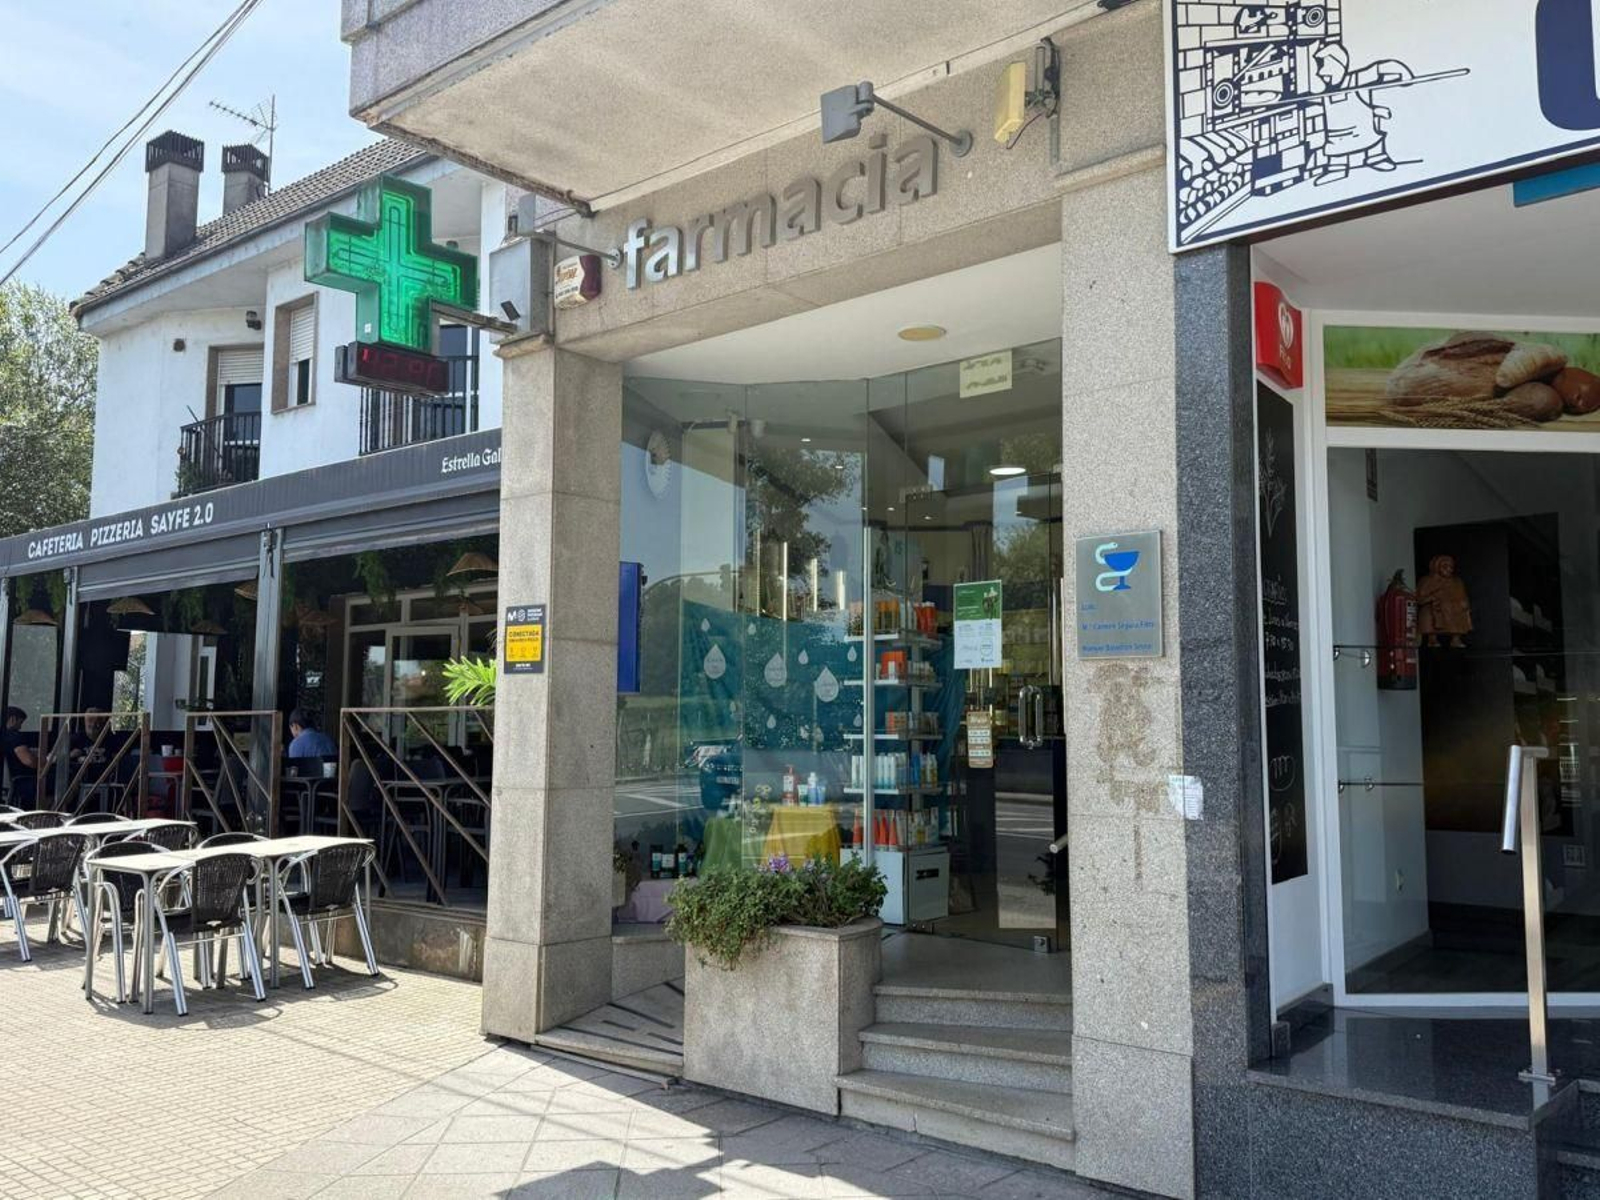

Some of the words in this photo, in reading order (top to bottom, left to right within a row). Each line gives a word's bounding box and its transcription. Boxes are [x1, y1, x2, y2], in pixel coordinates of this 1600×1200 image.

[623, 133, 938, 290] farmacia
[441, 452, 481, 473] Estrella
[28, 531, 84, 559] CAFETERIA
[90, 518, 144, 547] PIZZERIA
[150, 507, 190, 535] SAYFE
[193, 502, 214, 526] 2.0
